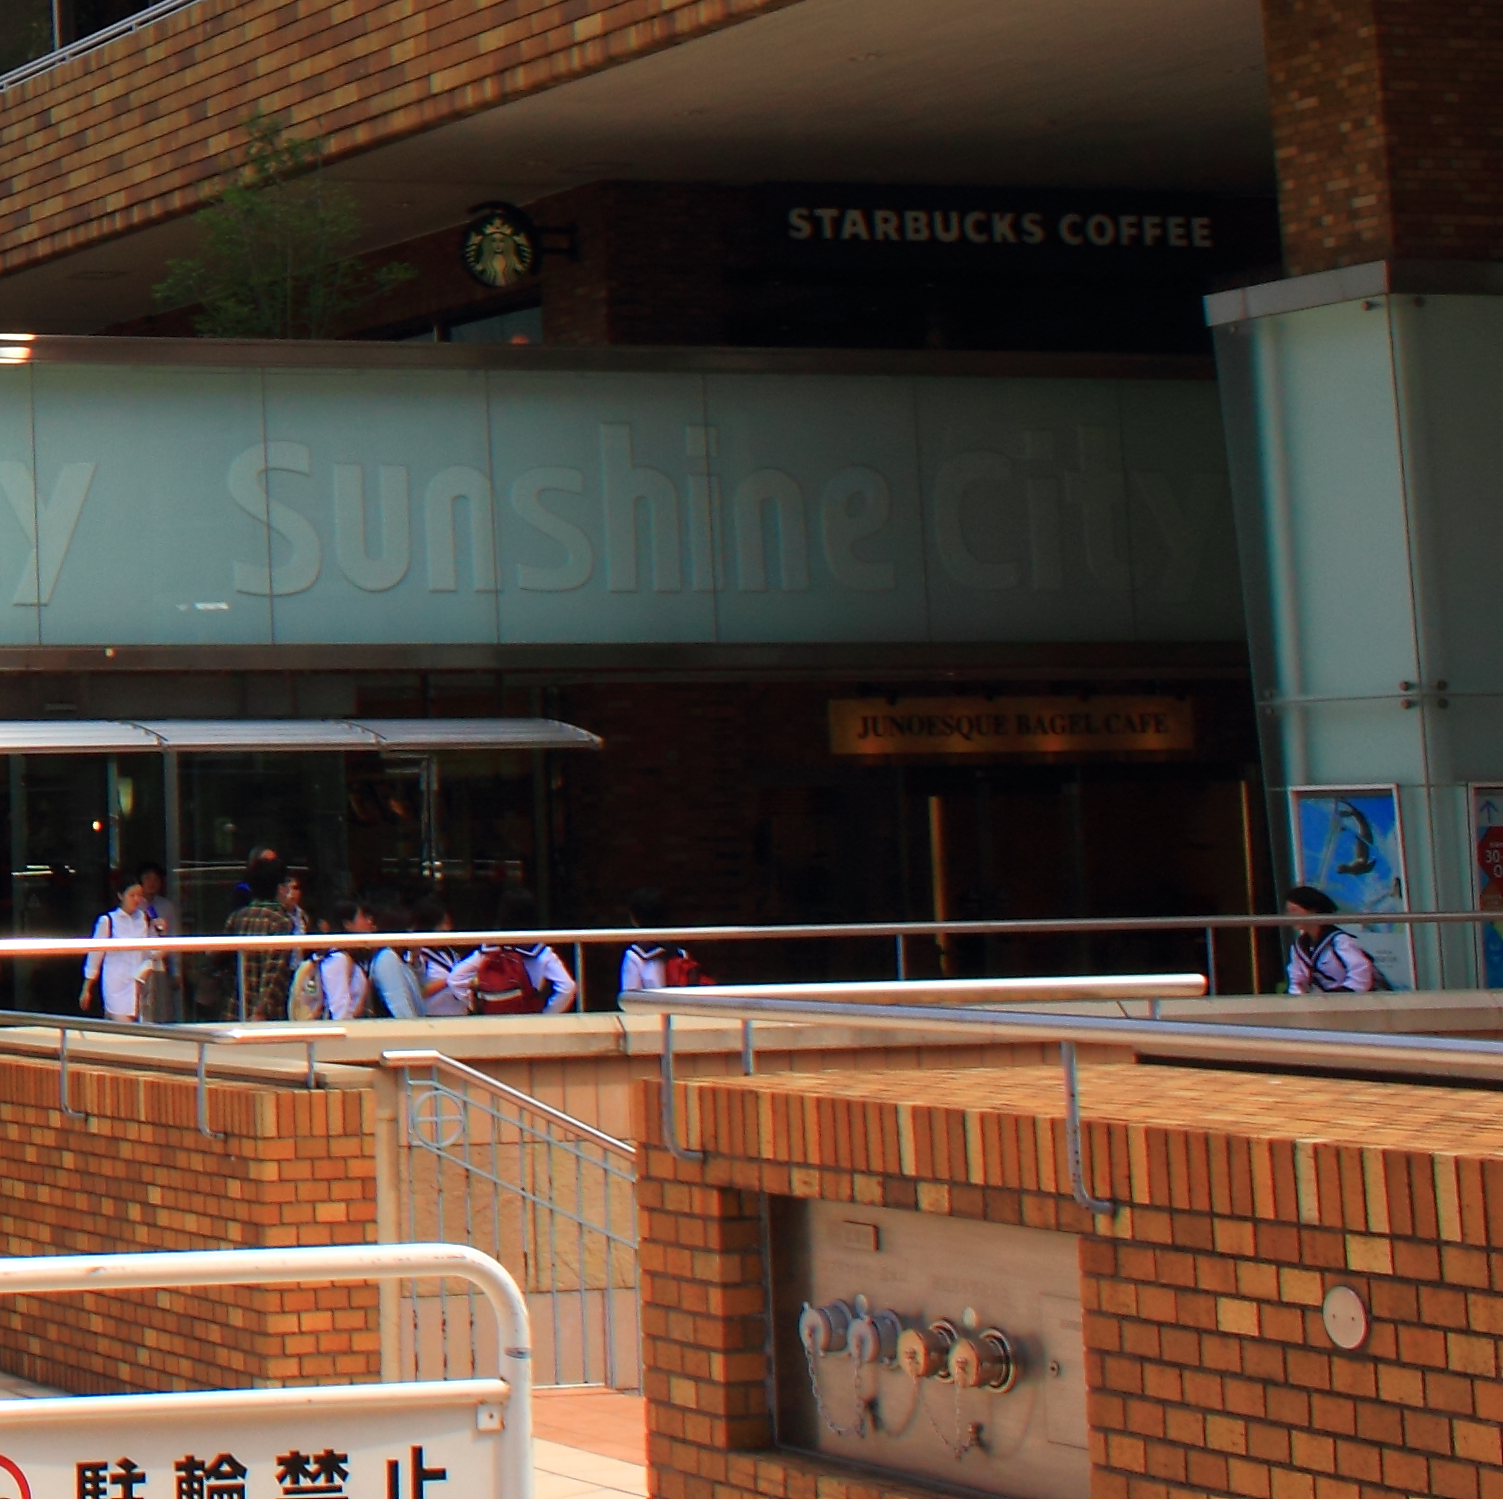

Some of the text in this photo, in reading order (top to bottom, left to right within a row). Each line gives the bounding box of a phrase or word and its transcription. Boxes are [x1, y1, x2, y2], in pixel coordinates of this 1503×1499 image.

[787, 207, 1214, 248] STARBUCKS COFFEE
[226, 420, 1231, 605] Sunshine City
[858, 712, 1169, 740] JUNOESQUE BAGEL CAFE
[74, 1444, 448, 1499] 駐輪禁止
